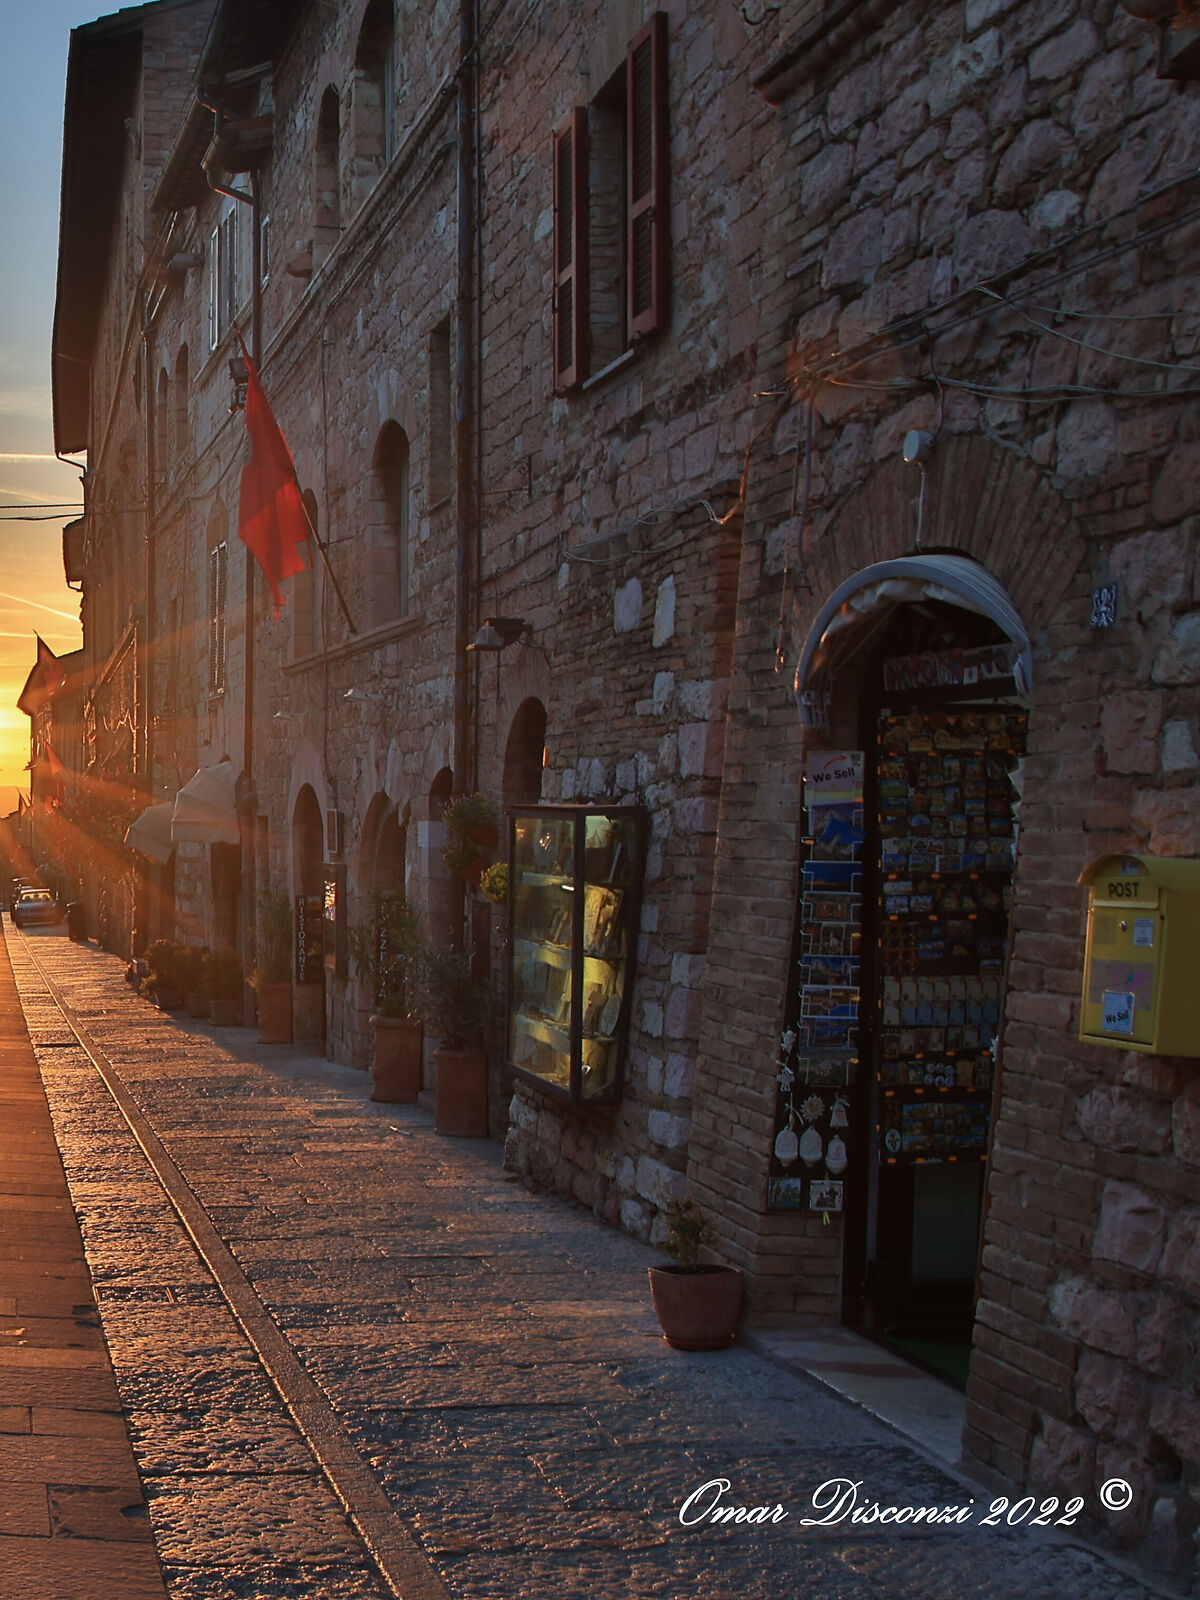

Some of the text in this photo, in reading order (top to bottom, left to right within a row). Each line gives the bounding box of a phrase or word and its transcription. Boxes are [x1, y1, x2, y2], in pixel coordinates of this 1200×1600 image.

[812, 767, 856, 783] We Sell
[1108, 882, 1139, 898] POST
[298, 897, 306, 981] RISTORANTE
[1105, 1014, 1117, 1024] We
